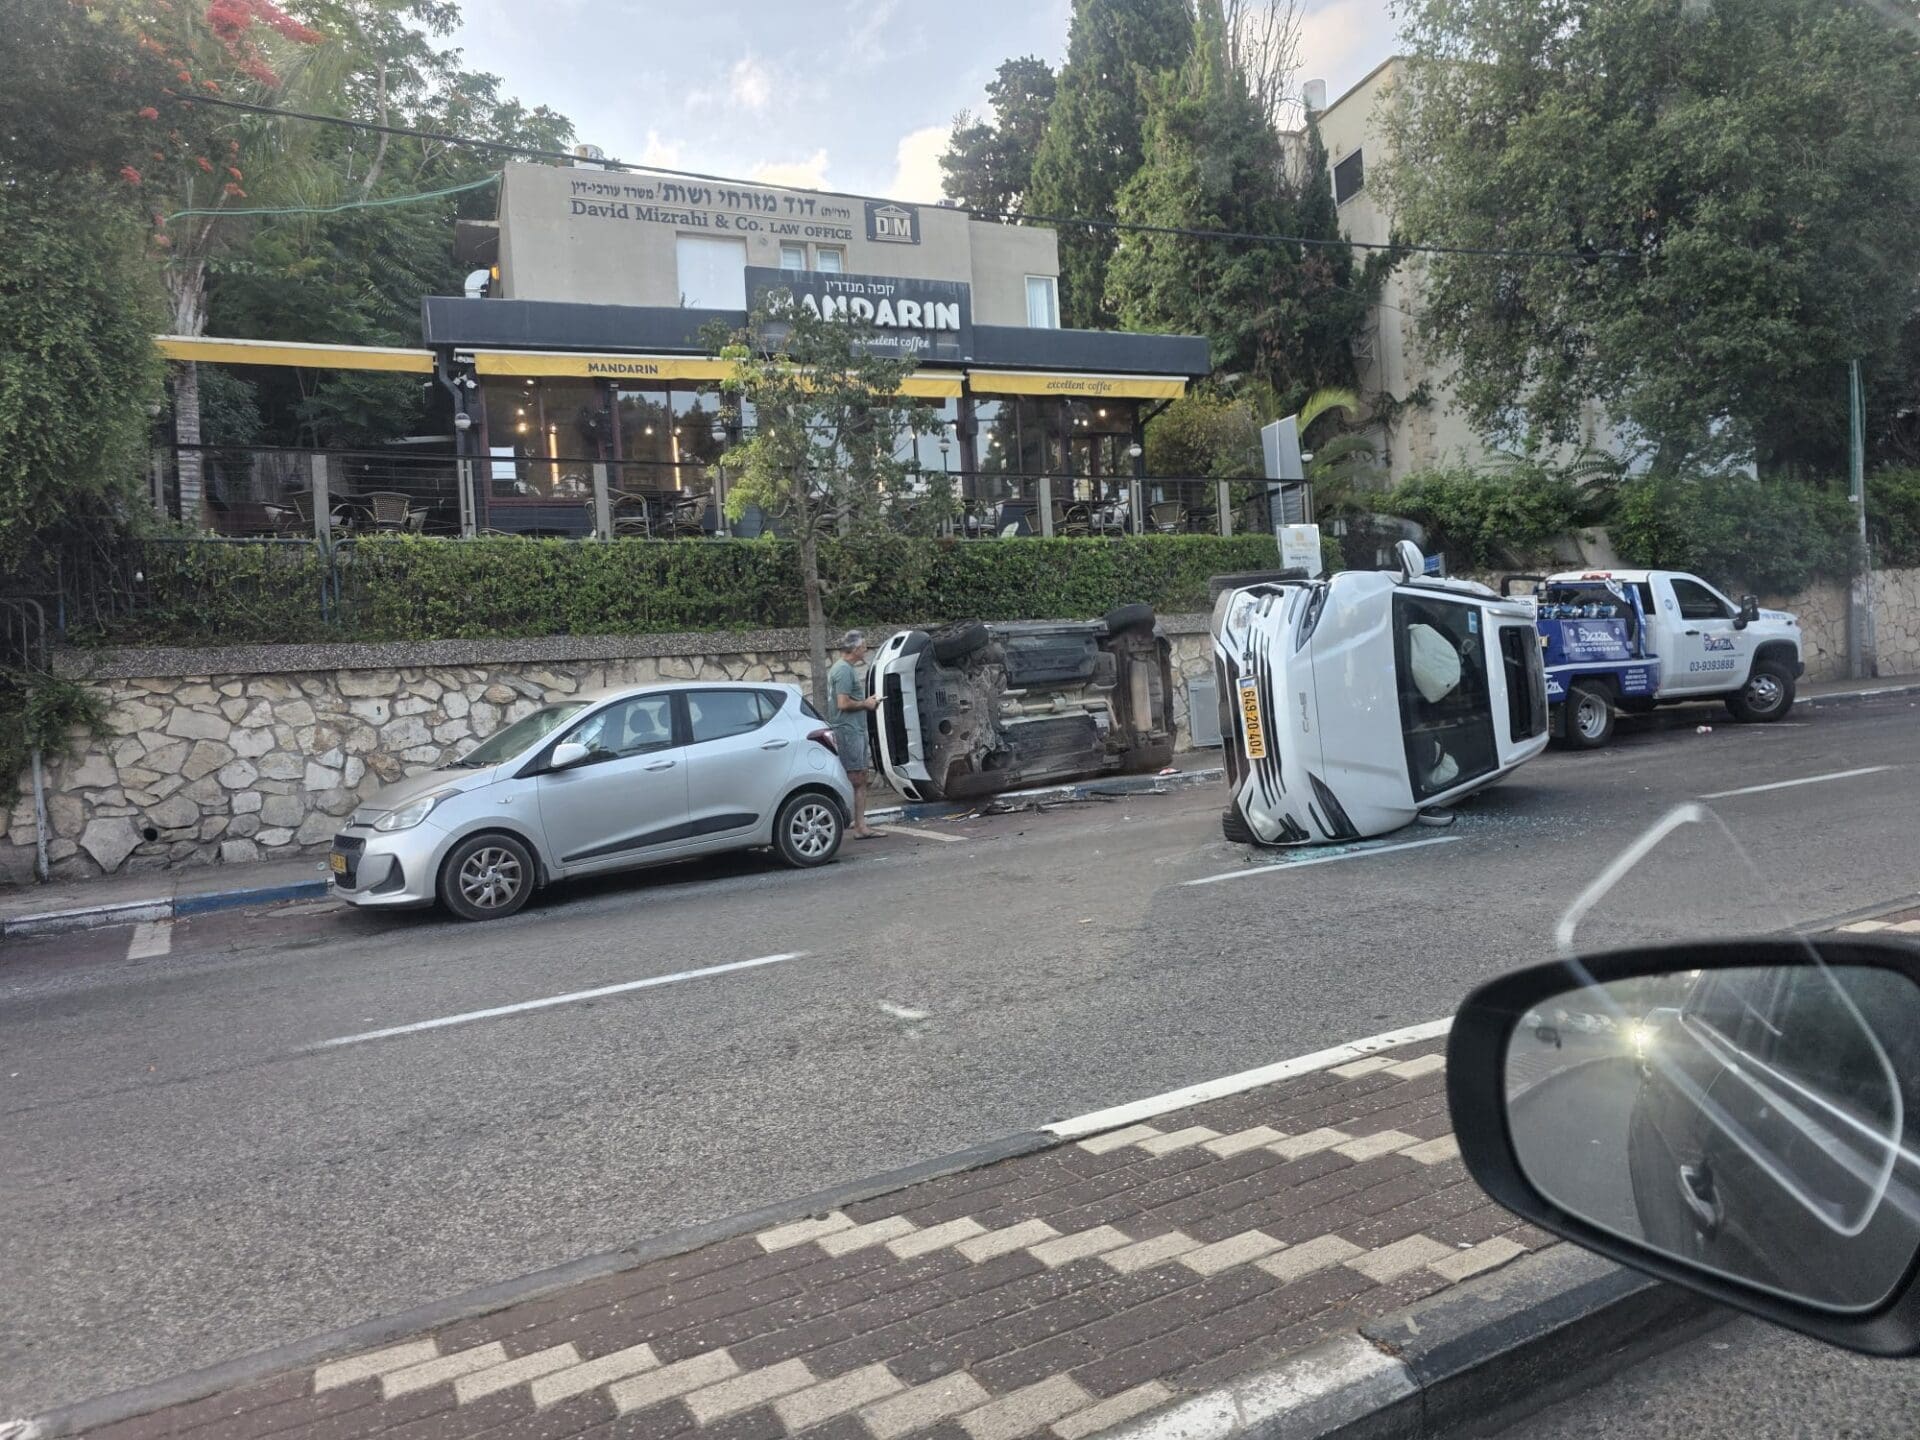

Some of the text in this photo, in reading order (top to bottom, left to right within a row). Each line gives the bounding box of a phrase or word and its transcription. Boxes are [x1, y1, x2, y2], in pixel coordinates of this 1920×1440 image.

[624, 186, 654, 199] משרד
[718, 190, 777, 212] מזרחי
[783, 196, 816, 216] דוד
[571, 200, 853, 240] David Mizrahi & Co. LAW OFFICE
[825, 280, 895, 296] קפה מנדרין
[900, 336, 930, 352] coffee
[588, 363, 658, 374] MANDARIN
[1047, 380, 1112, 394] excellent coffee
[1690, 659, 1735, 671] 03-9393888
